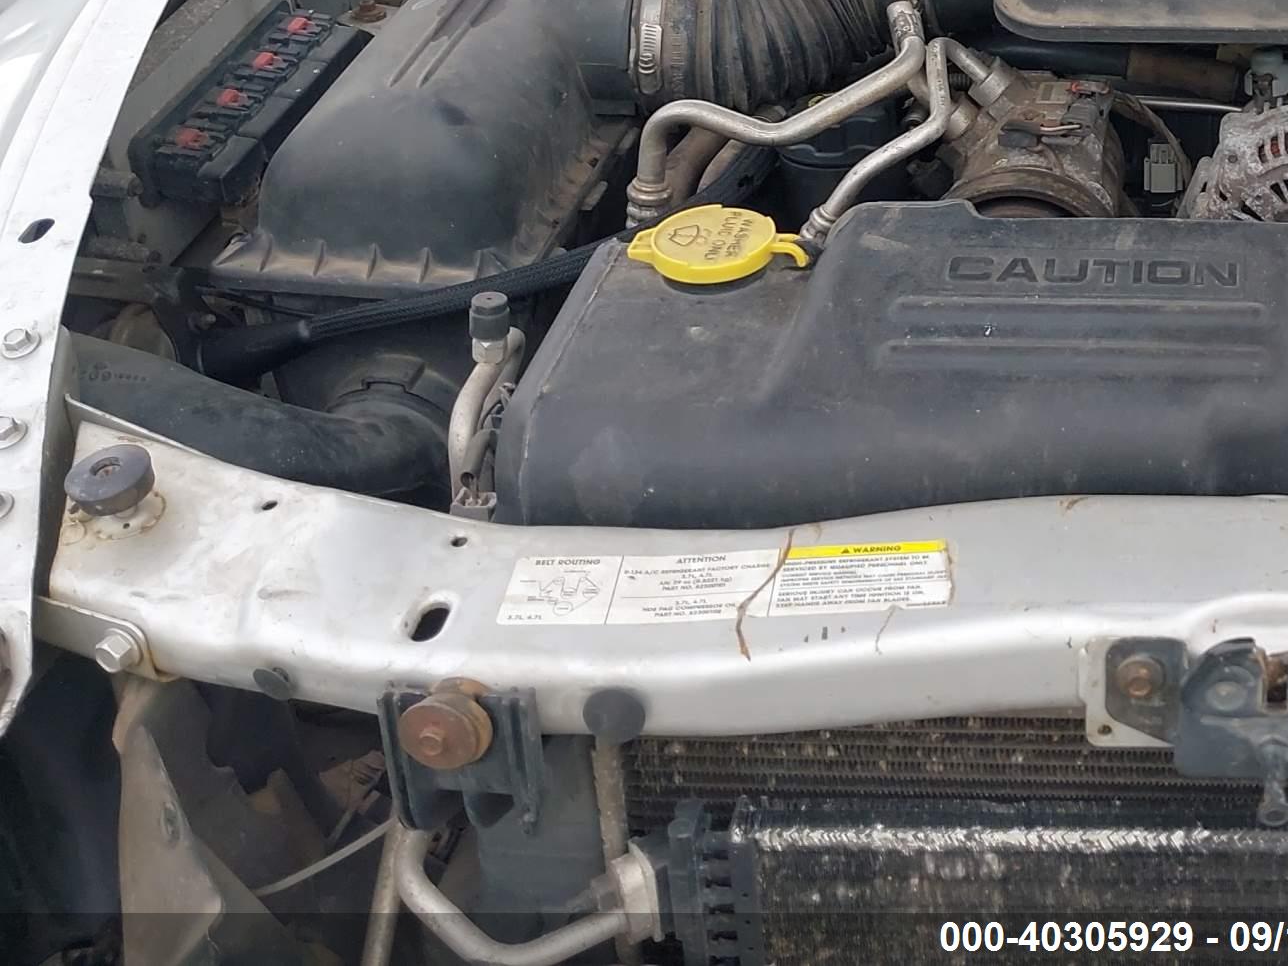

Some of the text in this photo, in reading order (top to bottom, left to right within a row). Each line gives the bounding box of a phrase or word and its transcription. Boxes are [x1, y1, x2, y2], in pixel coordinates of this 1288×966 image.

[724, 218, 753, 258] WASHER
[947, 255, 1239, 287] CAUTION
[676, 555, 727, 564] ATTENTION
[853, 545, 901, 554] WARNING
